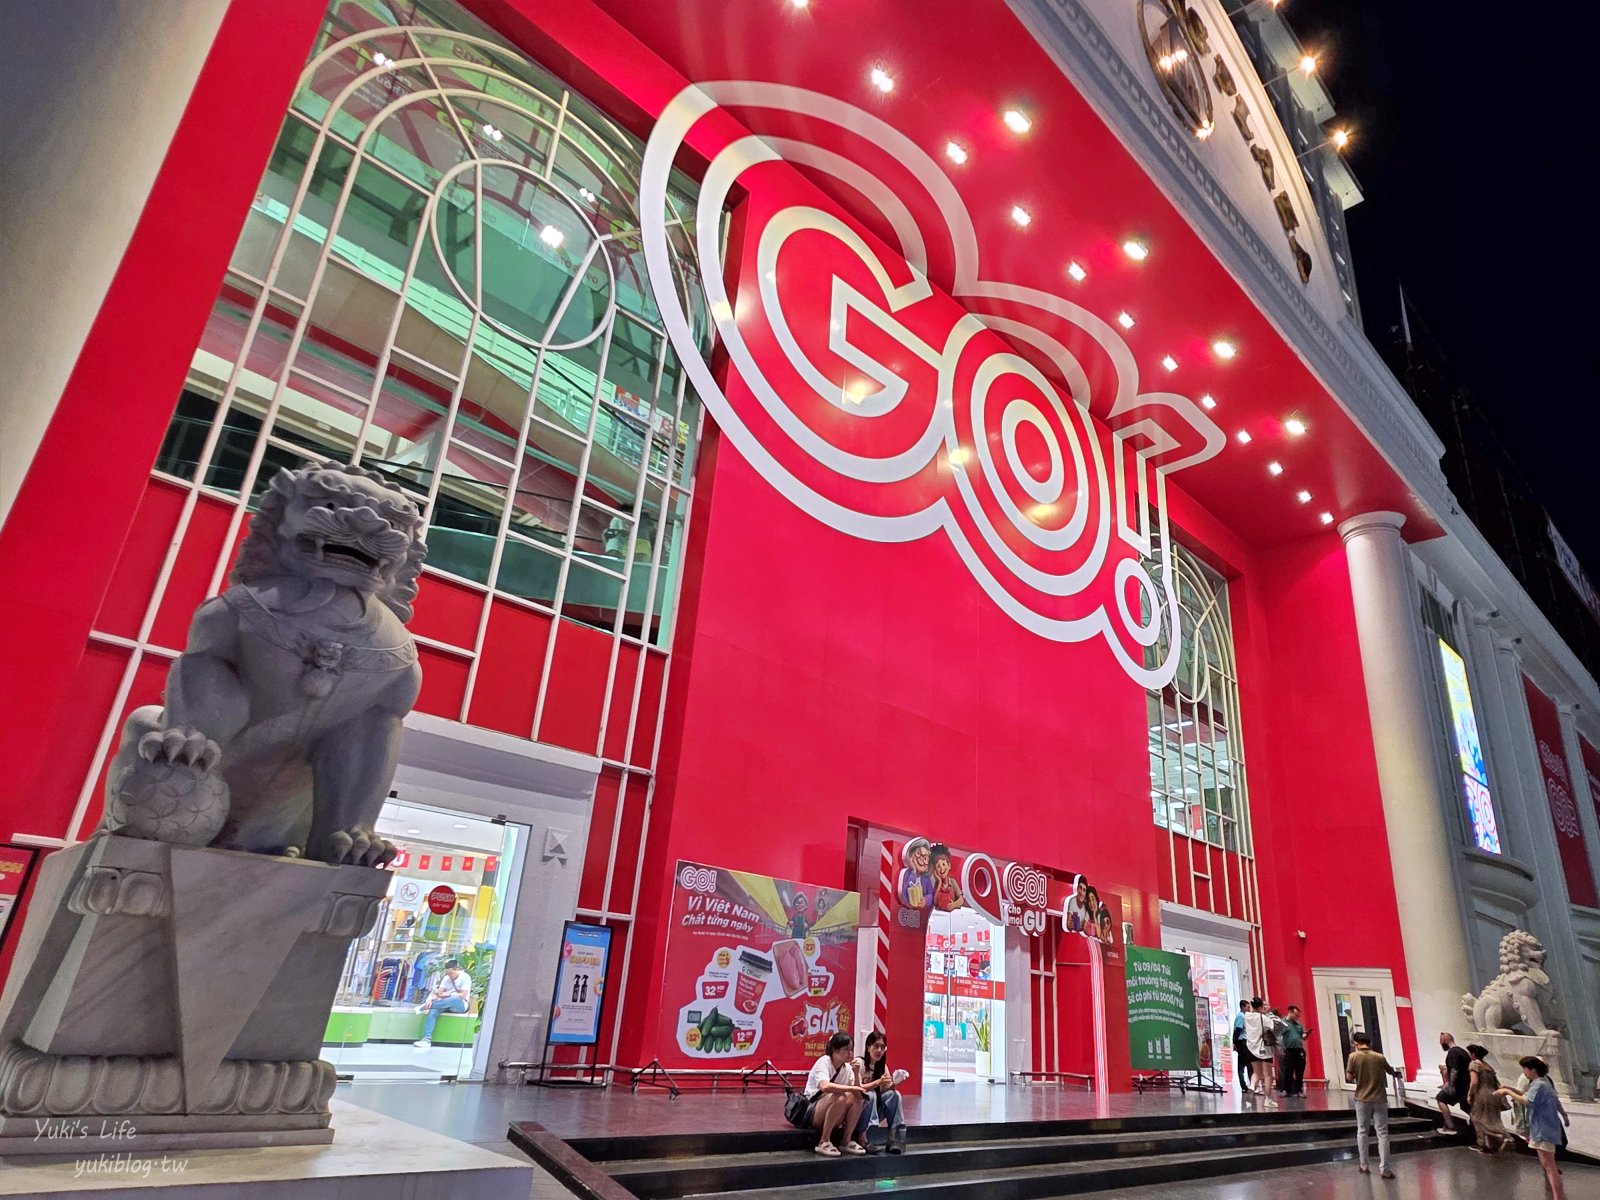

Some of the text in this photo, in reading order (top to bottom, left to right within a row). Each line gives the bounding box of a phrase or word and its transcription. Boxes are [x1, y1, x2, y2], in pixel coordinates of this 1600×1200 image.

[640, 80, 1226, 689] GO!
[680, 866, 717, 893] GO!
[1008, 865, 1047, 909] GO!
[705, 897, 731, 914] Việt
[731, 904, 760, 923] Nam
[1008, 905, 1021, 915] cho
[1023, 909, 1046, 933] GU
[704, 985, 716, 996] 32
